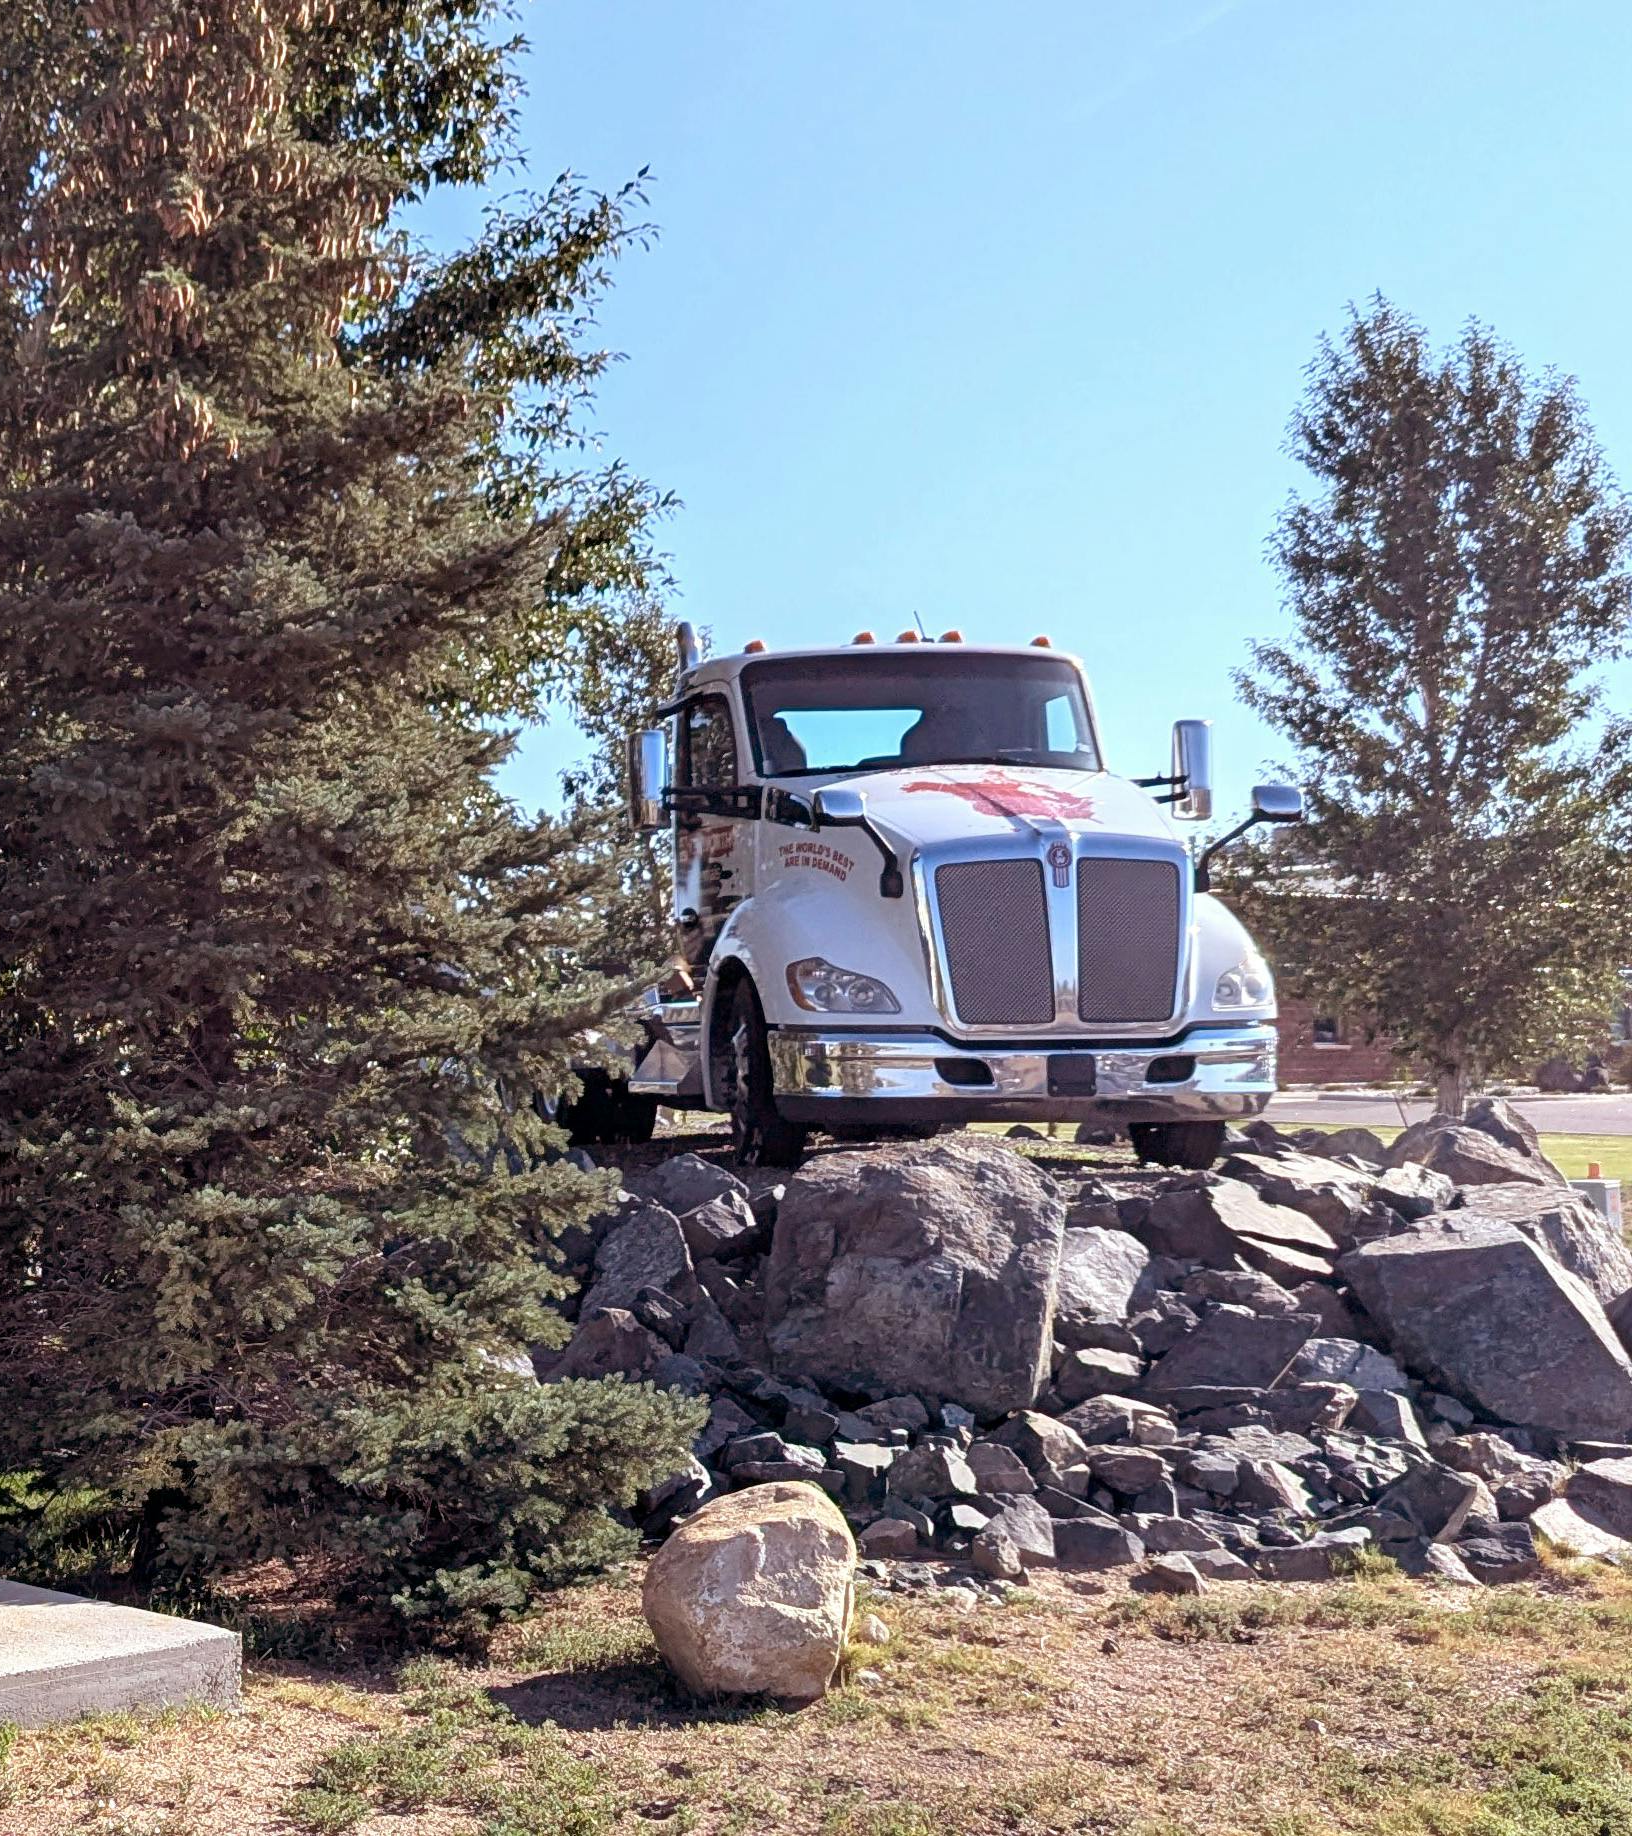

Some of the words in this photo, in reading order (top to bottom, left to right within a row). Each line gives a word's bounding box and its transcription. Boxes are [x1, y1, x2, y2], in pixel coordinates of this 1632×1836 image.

[779, 843, 793, 856] THE
[796, 842, 830, 857] WORLD'S
[832, 851, 854, 871] BEST
[785, 856, 800, 867] ARE
[801, 856, 810, 866] IN
[812, 857, 846, 881] DEMAND
